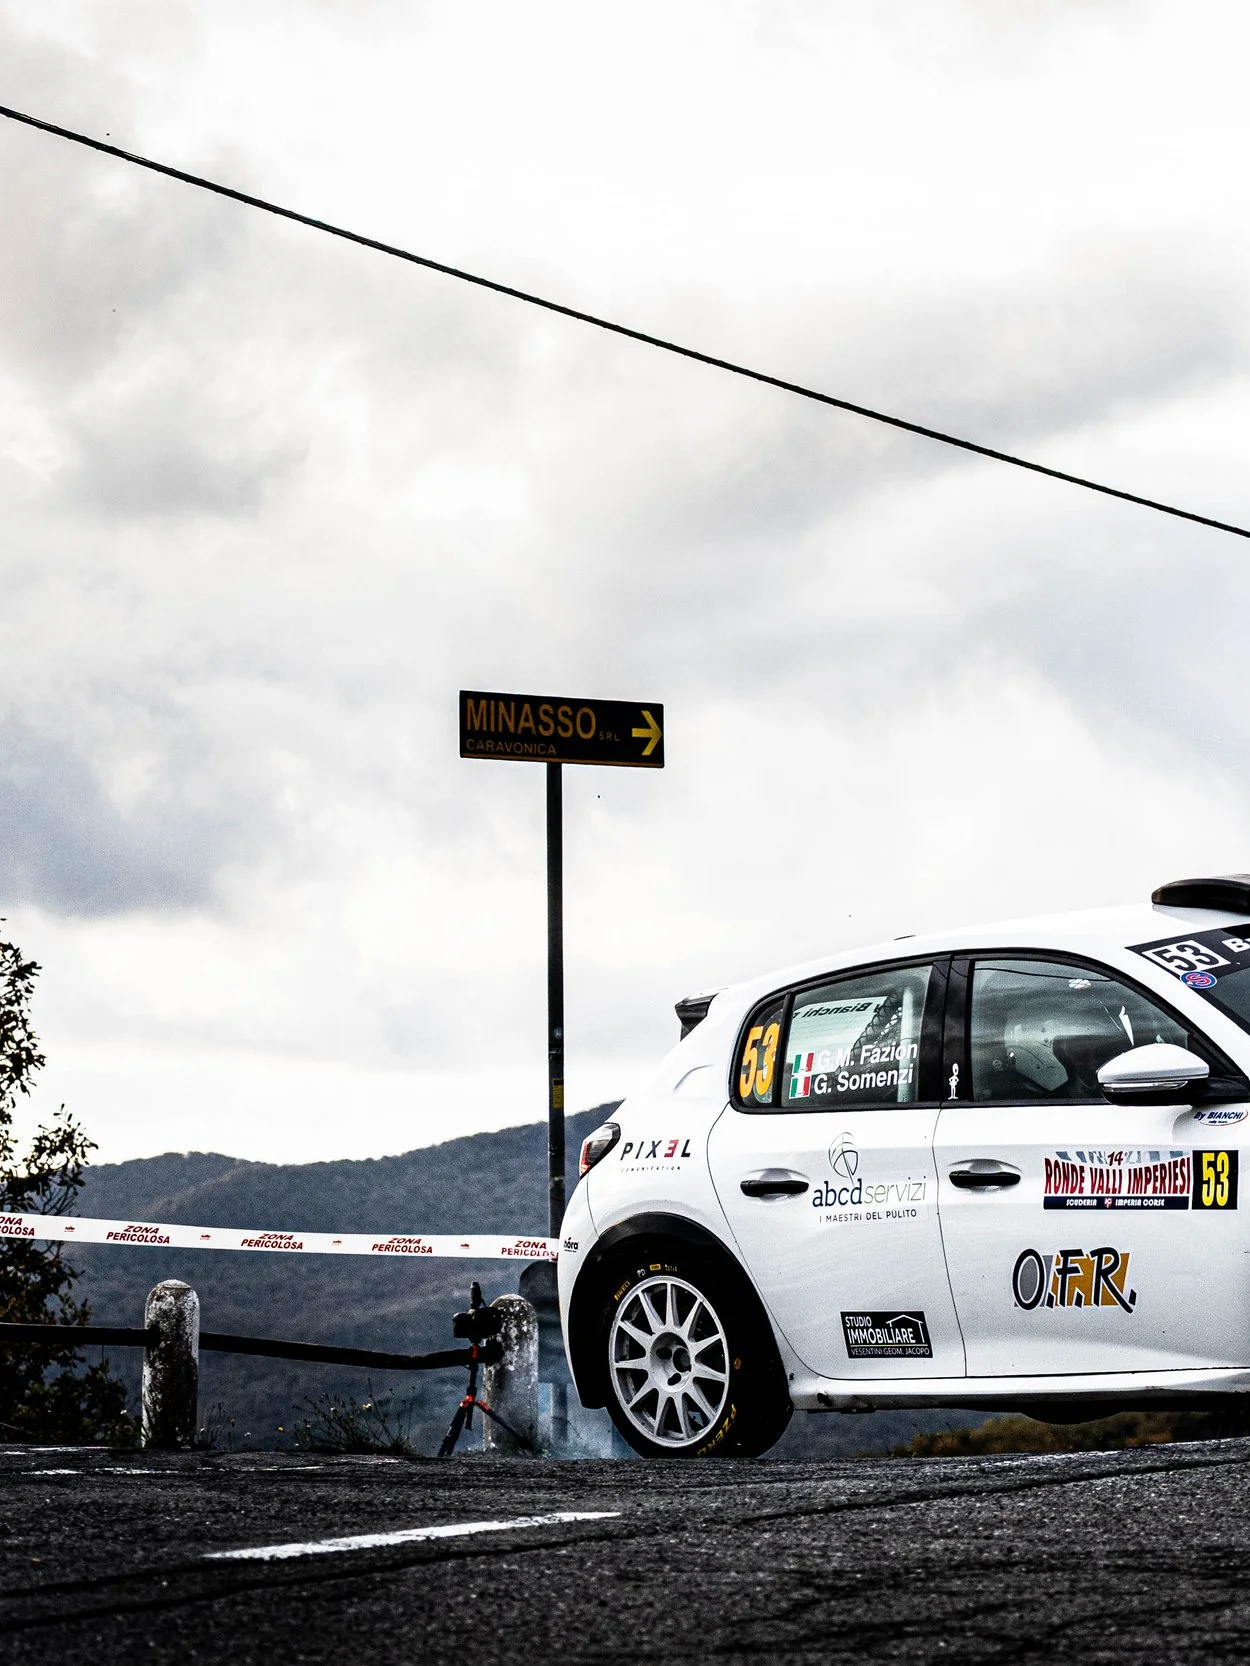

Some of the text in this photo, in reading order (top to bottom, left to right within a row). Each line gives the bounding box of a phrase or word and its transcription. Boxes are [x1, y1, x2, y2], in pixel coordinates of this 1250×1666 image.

[466, 698, 596, 739] MINASSO
[466, 738, 557, 755] CARAVONICA
[1152, 944, 1219, 971] 53
[860, 1041, 919, 1065] Fazion
[739, 1022, 780, 1098] 53
[814, 1063, 914, 1095] G. Somenzi
[1193, 1111, 1244, 1121] By BIANCHI
[1044, 1156, 1191, 1195] RONDE VALLI IMPERIESI
[1201, 1151, 1230, 1207] 53
[1066, 1198, 1165, 1207] SCUDERIA IMPERIA CORSE
[826, 1213, 862, 1223] MAESTRI
[866, 1212, 882, 1221] DEL
[886, 1209, 917, 1219] PULITO
[123, 1225, 160, 1234] ZONA
[106, 1231, 171, 1244] PERICOLOSA
[258, 1233, 295, 1241] ZONA
[387, 1237, 422, 1245] ZONA
[240, 1238, 304, 1250] PERICOLOSA
[371, 1243, 433, 1254] PERICOLOSA
[514, 1240, 547, 1250] ZONA
[1012, 1246, 1137, 1314] O.F.R.
[845, 1316, 872, 1327] STUDIO
[847, 1328, 916, 1344] IMMOBILIARE
[850, 1347, 882, 1356] VESENTINI
[905, 1347, 930, 1355] JACOPO
